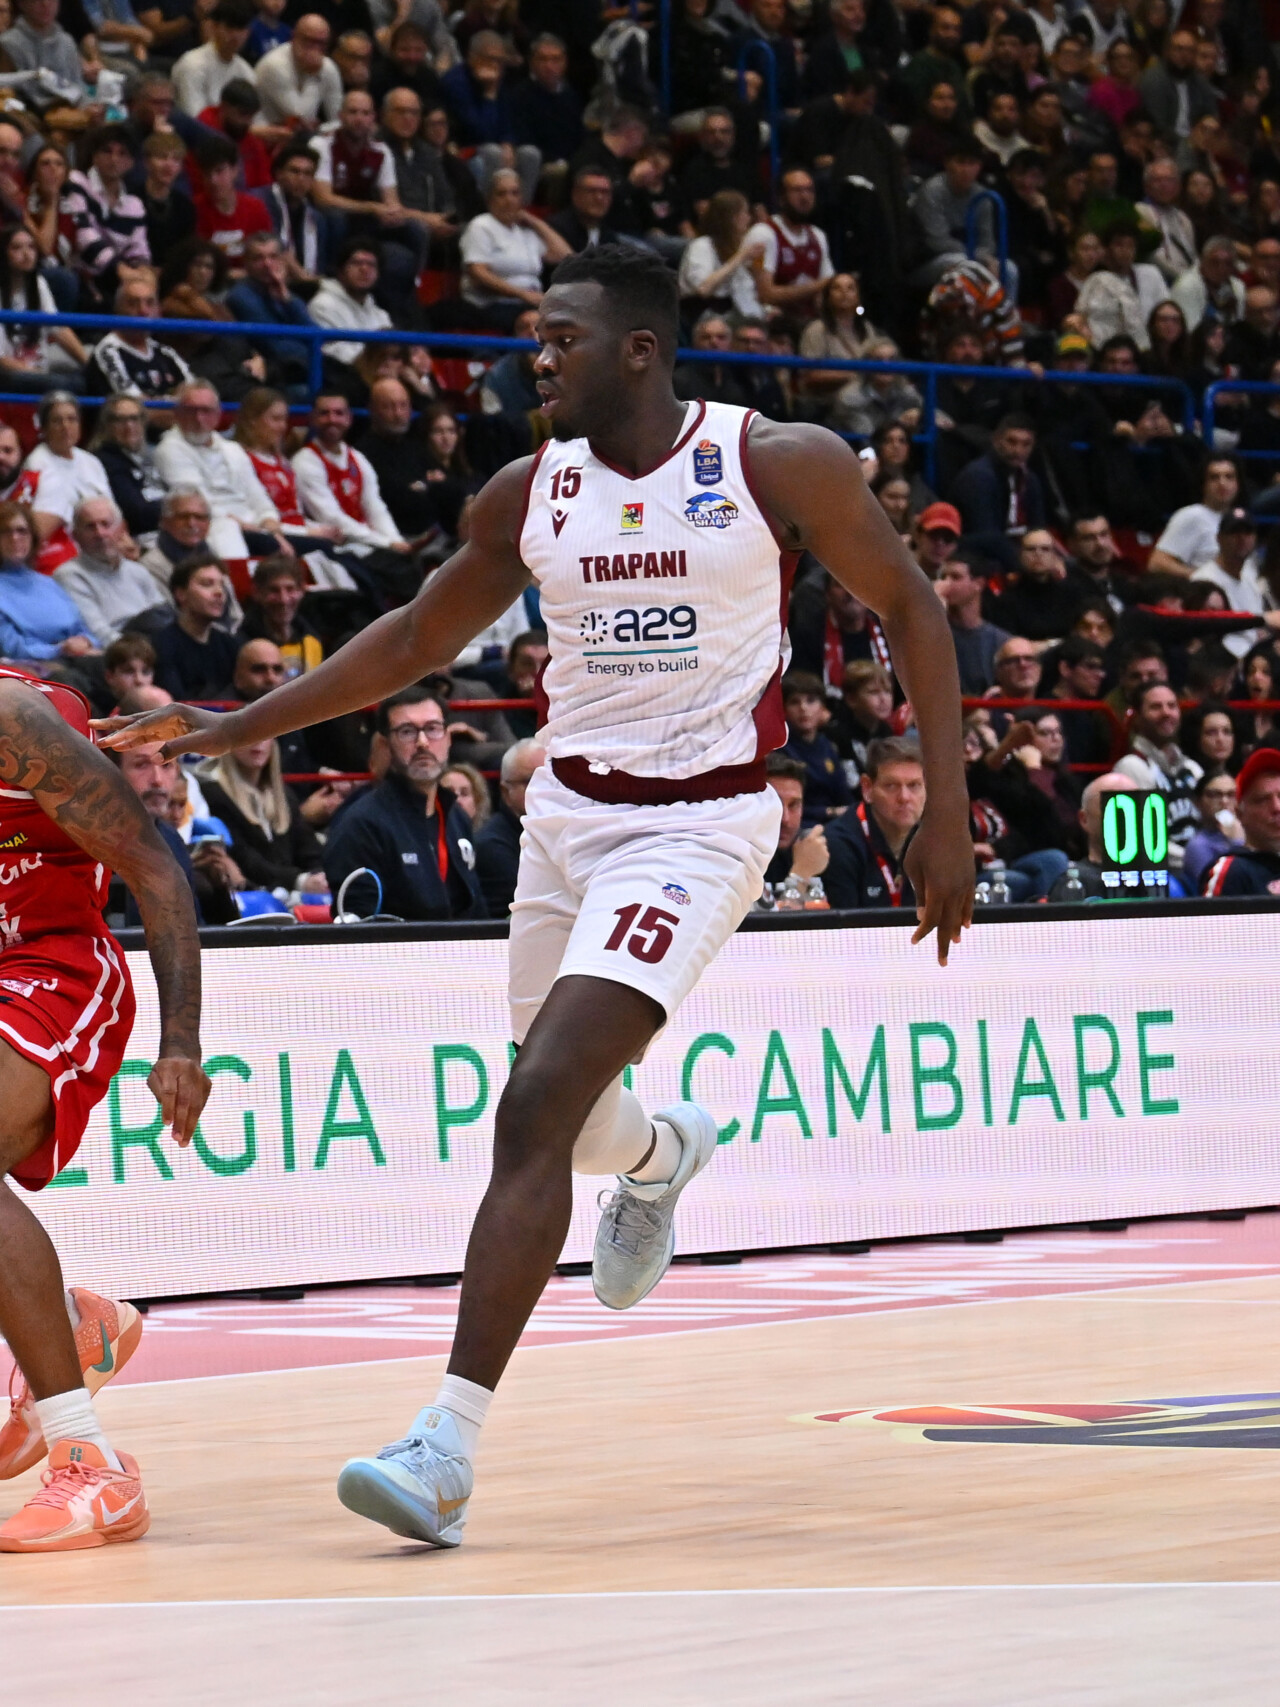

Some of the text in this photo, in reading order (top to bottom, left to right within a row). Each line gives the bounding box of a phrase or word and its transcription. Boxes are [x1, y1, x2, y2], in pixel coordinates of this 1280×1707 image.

[696, 457, 720, 467] LBA
[550, 466, 584, 501] 15
[687, 509, 738, 521] TRAPANI
[695, 518, 731, 527] SHARK
[579, 550, 687, 583] TRAPANI
[613, 605, 697, 642] a29
[587, 656, 699, 676] Energy to build
[603, 902, 681, 965] 15
[681, 1010, 1180, 1145] CAMBIARE
